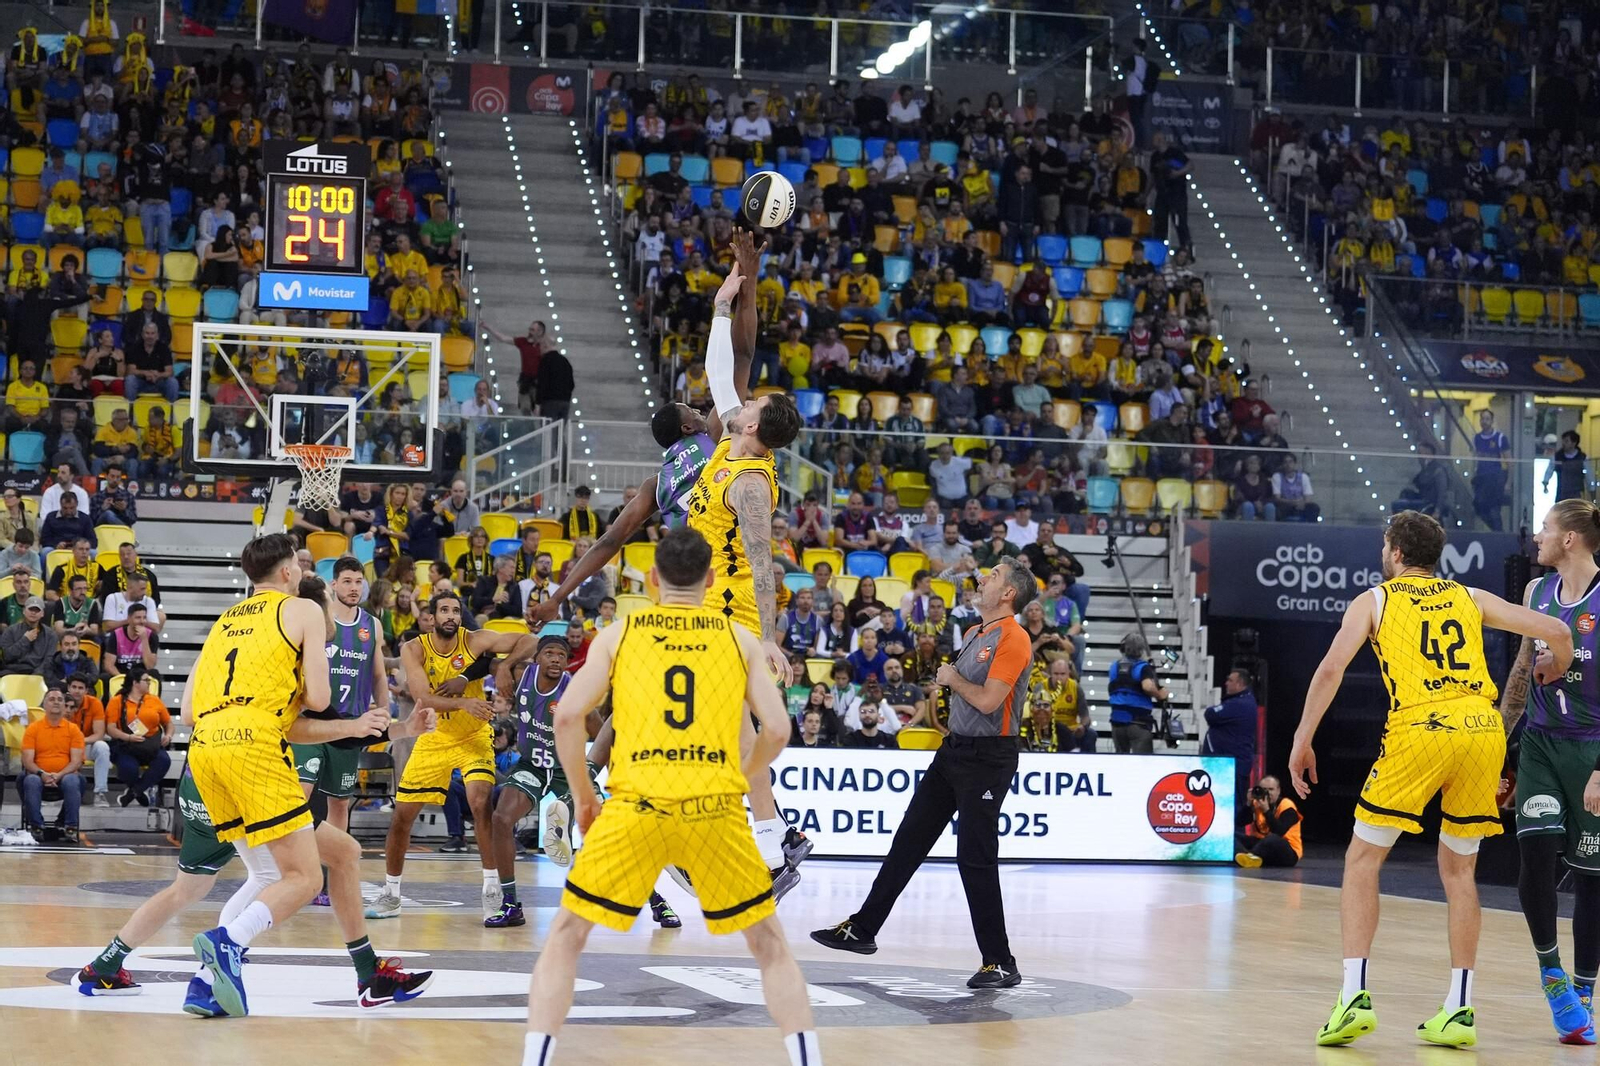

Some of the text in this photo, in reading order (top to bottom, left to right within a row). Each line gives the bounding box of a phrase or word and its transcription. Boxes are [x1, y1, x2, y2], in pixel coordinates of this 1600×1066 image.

[285, 157, 348, 175] LOTUS
[288, 185, 355, 214] 10:00
[769, 199, 781, 221] EVO
[284, 215, 346, 262] 24
[308, 287, 356, 299] Movistar
[1275, 543, 1324, 564] acb
[1256, 558, 1347, 594] Copa
[223, 600, 267, 618] KRAMER
[1276, 595, 1320, 612] Gran
[633, 614, 725, 631] MARCELINHO
[1420, 618, 1471, 671] 42
[224, 647, 239, 697] 1
[339, 685, 351, 703] 7
[664, 664, 695, 731] 9
[1556, 688, 1568, 715] 1
[212, 728, 254, 743] CICAR
[531, 748, 555, 768] 55
[1158, 800, 1193, 813] Copa
[1165, 793, 1185, 802] acb
[833, 810, 892, 833] DEL
[1174, 813, 1198, 827] Rey
